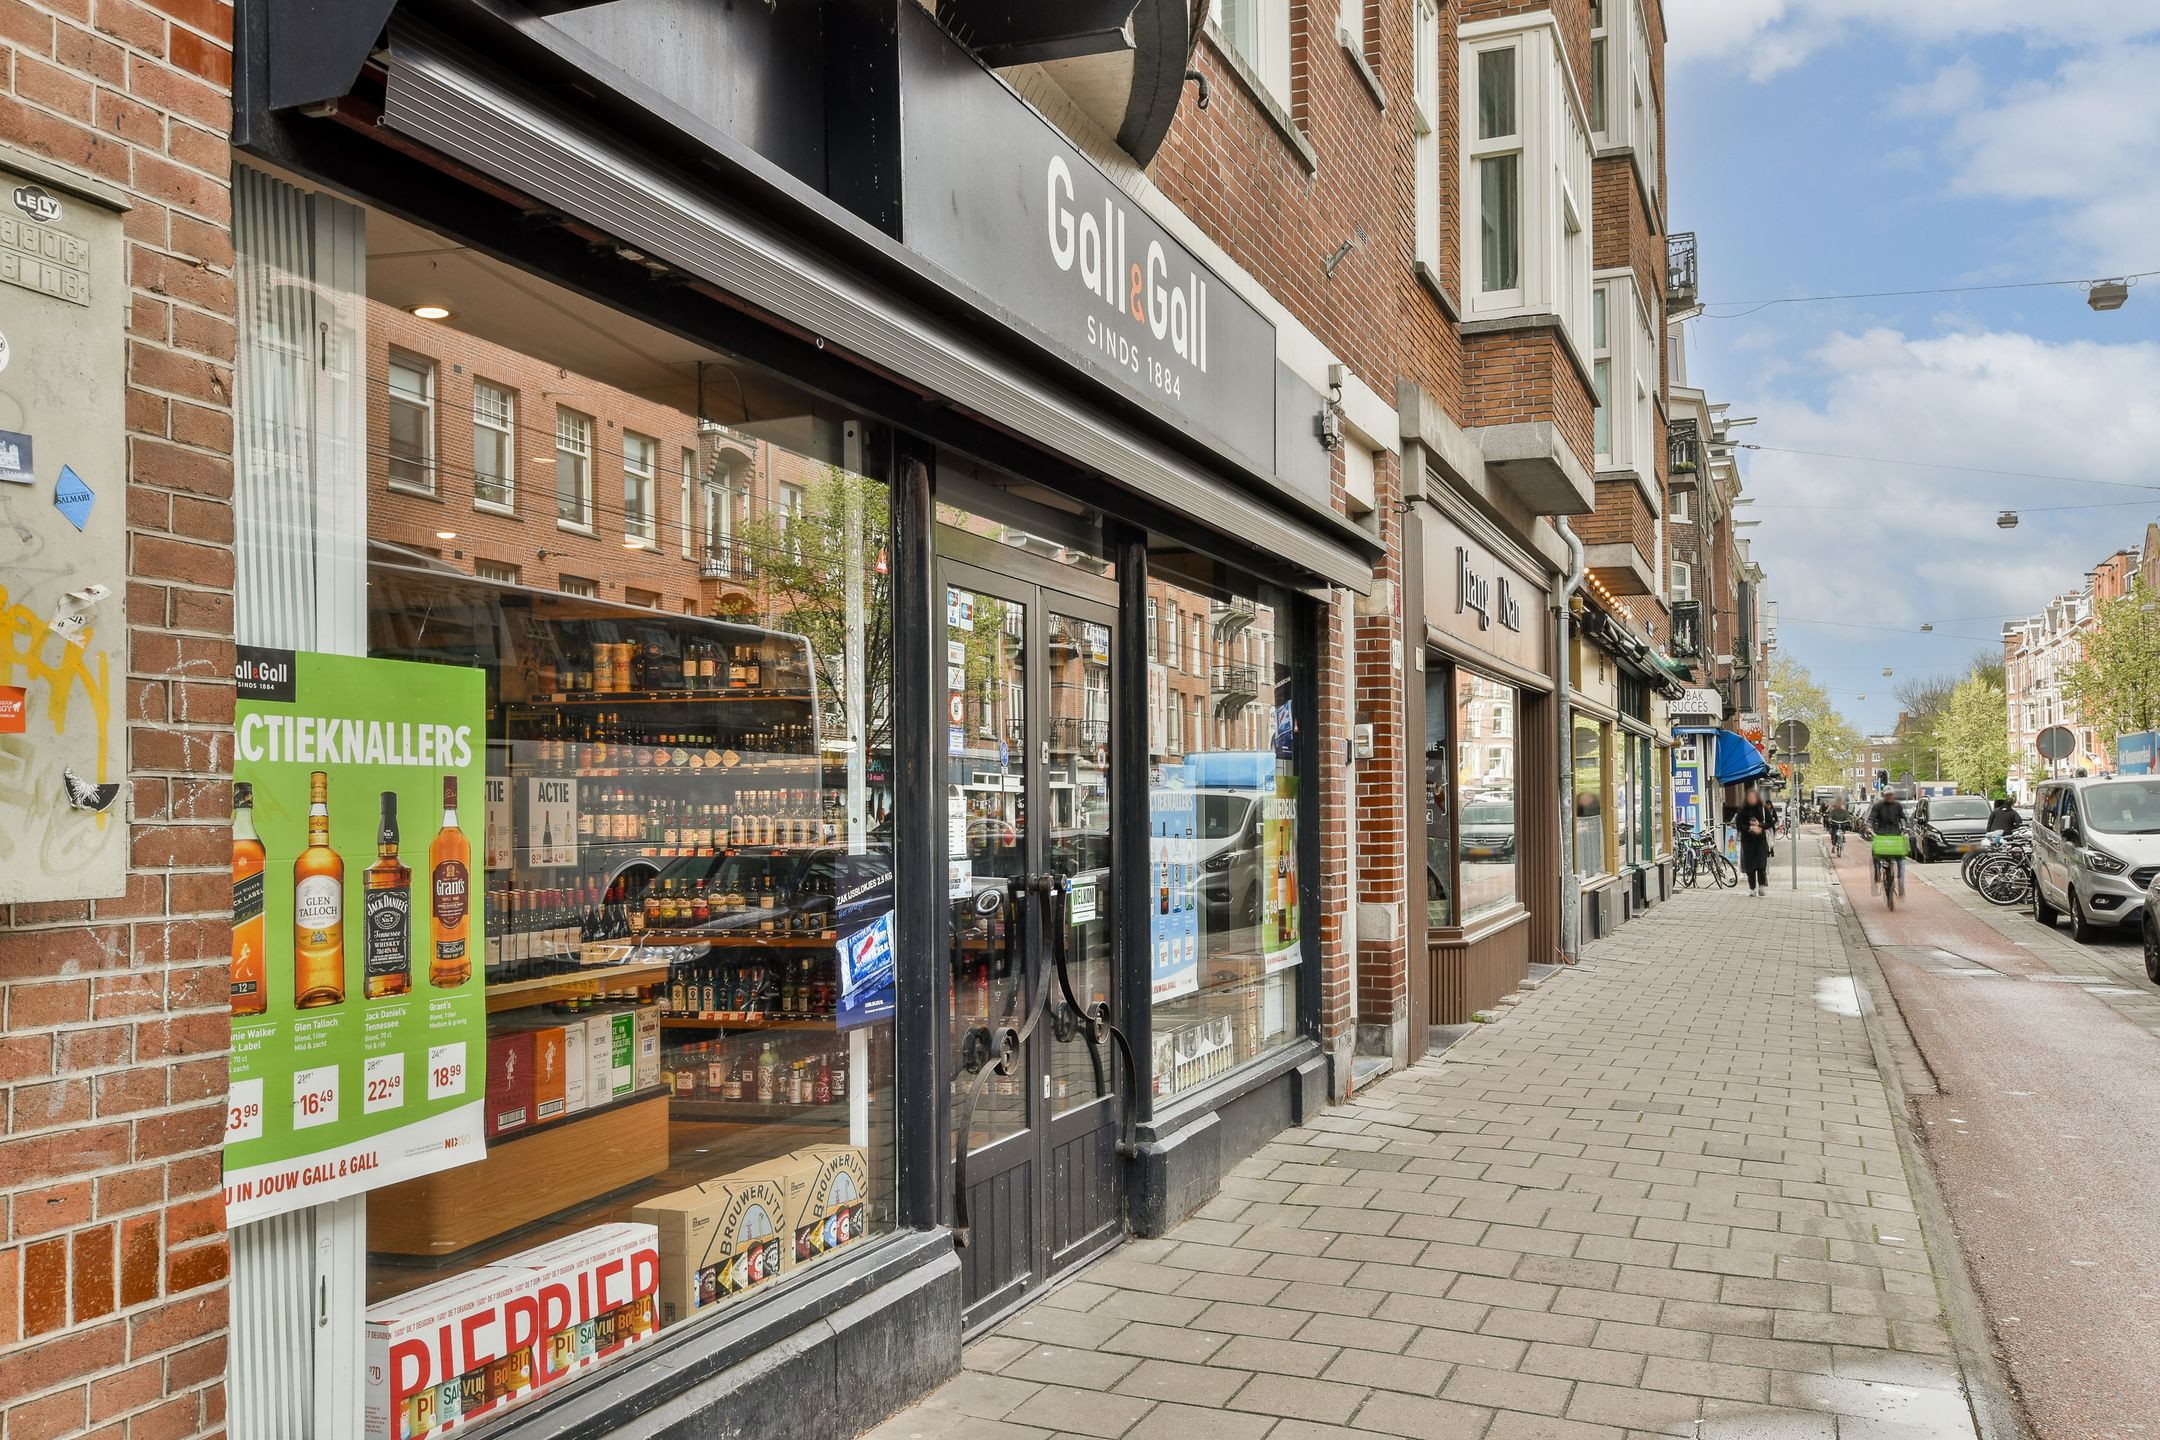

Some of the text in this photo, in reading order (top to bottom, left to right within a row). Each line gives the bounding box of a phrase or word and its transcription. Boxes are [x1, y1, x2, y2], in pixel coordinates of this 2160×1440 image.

[15, 190, 58, 215] LELY
[1087, 315, 1181, 400] SINDS 1884
[56, 493, 90, 505] SALMARI
[235, 660, 287, 683] all&Gall
[237, 681, 257, 689] SINDS
[1672, 701, 1709, 713] SUCCES
[485, 780, 504, 802] TIE
[537, 782, 569, 803] ACTIE
[436, 879, 465, 896] Grant's
[306, 896, 331, 906] GLEN
[836, 893, 848, 906] ZAK
[299, 906, 338, 918] TALLOCH
[367, 898, 384, 916] JACK
[238, 983, 248, 993] 12
[429, 1001, 452, 1012] Grant's
[364, 1008, 406, 1021] Jack Daniel's
[294, 1018, 338, 1032] Glen Talloch
[365, 1020, 399, 1032] Tennessee
[247, 1028, 276, 1039] Walker
[238, 1041, 261, 1052] Label
[312, 1040, 327, 1049] zacht
[233, 1064, 249, 1073] zacht
[433, 1064, 461, 1088] 18.99
[367, 1075, 400, 1102] 22.49
[300, 1089, 333, 1116] 16.49
[224, 1103, 258, 1131] 3.99
[237, 1181, 252, 1203] IN
[256, 1171, 299, 1198] JOUW
[303, 1162, 335, 1186] GALL
[339, 1159, 347, 1178] &
[350, 1151, 379, 1174] GALL
[371, 1331, 391, 1340] DEUGDEN
